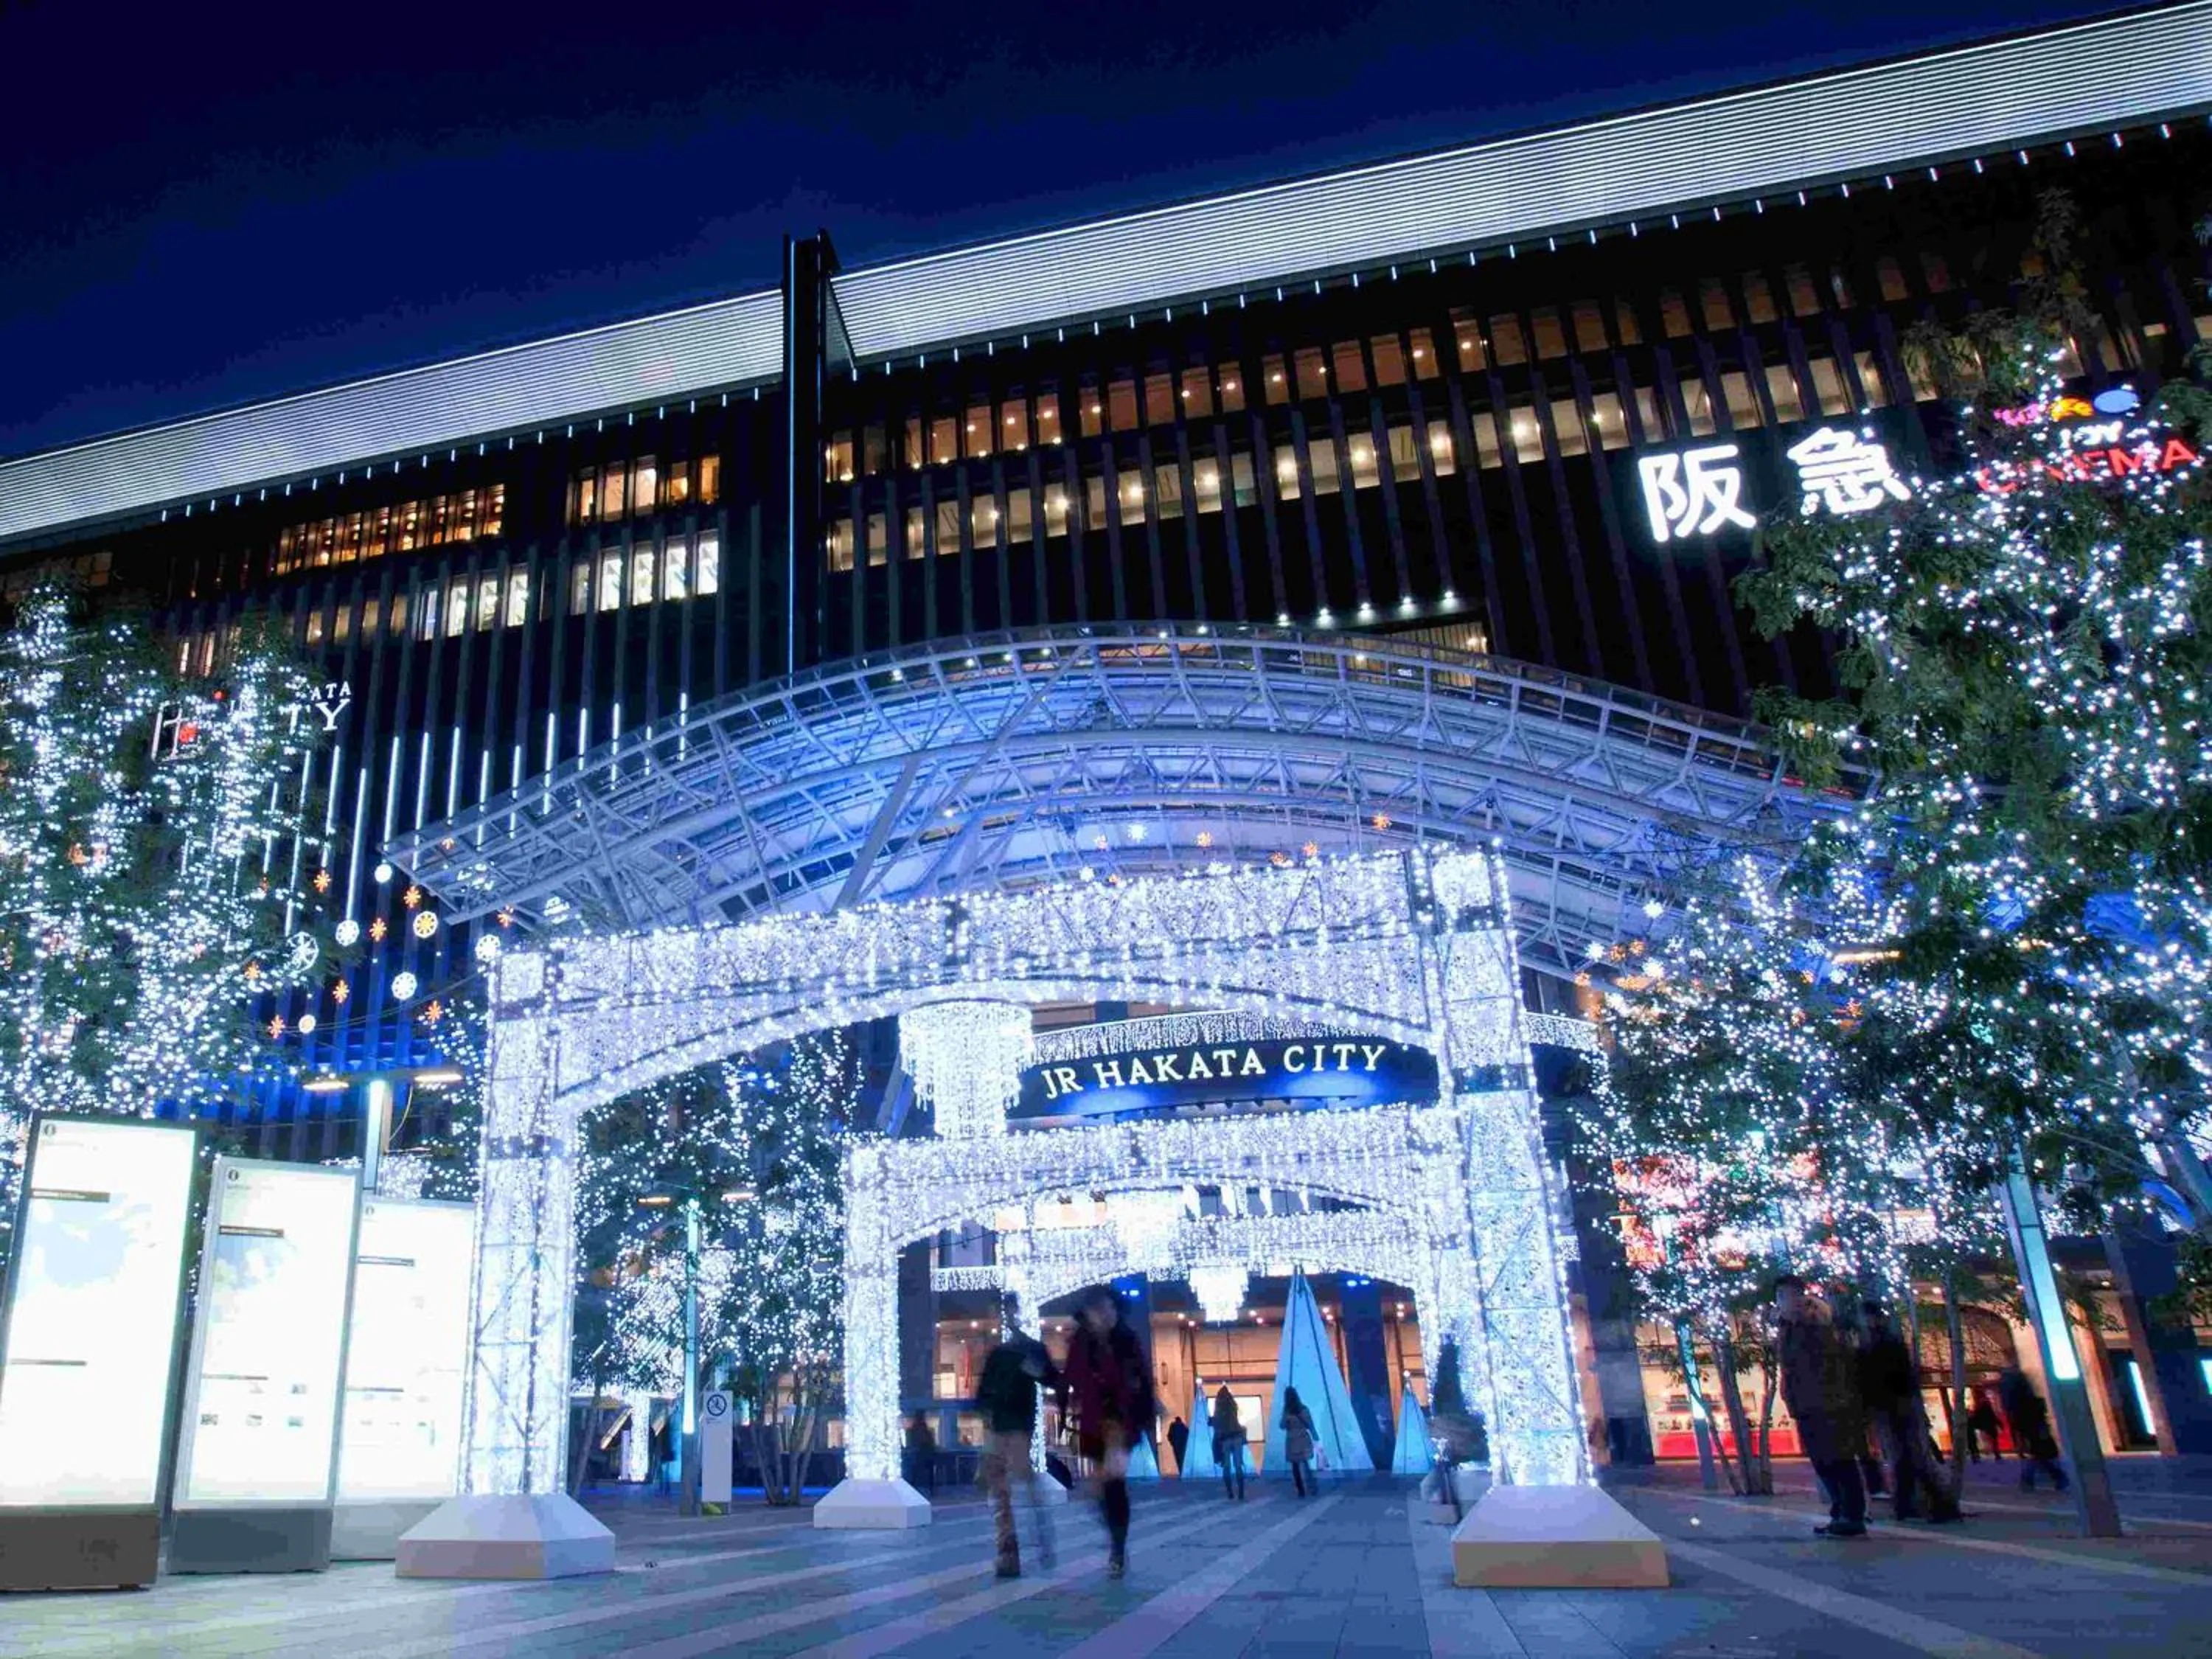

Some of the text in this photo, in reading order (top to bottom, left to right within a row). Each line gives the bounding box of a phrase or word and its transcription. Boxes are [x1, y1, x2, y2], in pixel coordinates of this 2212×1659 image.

[1638, 426, 1912, 543] 阪急
[1040, 1043, 1387, 1099] JR HAKATA CITY
